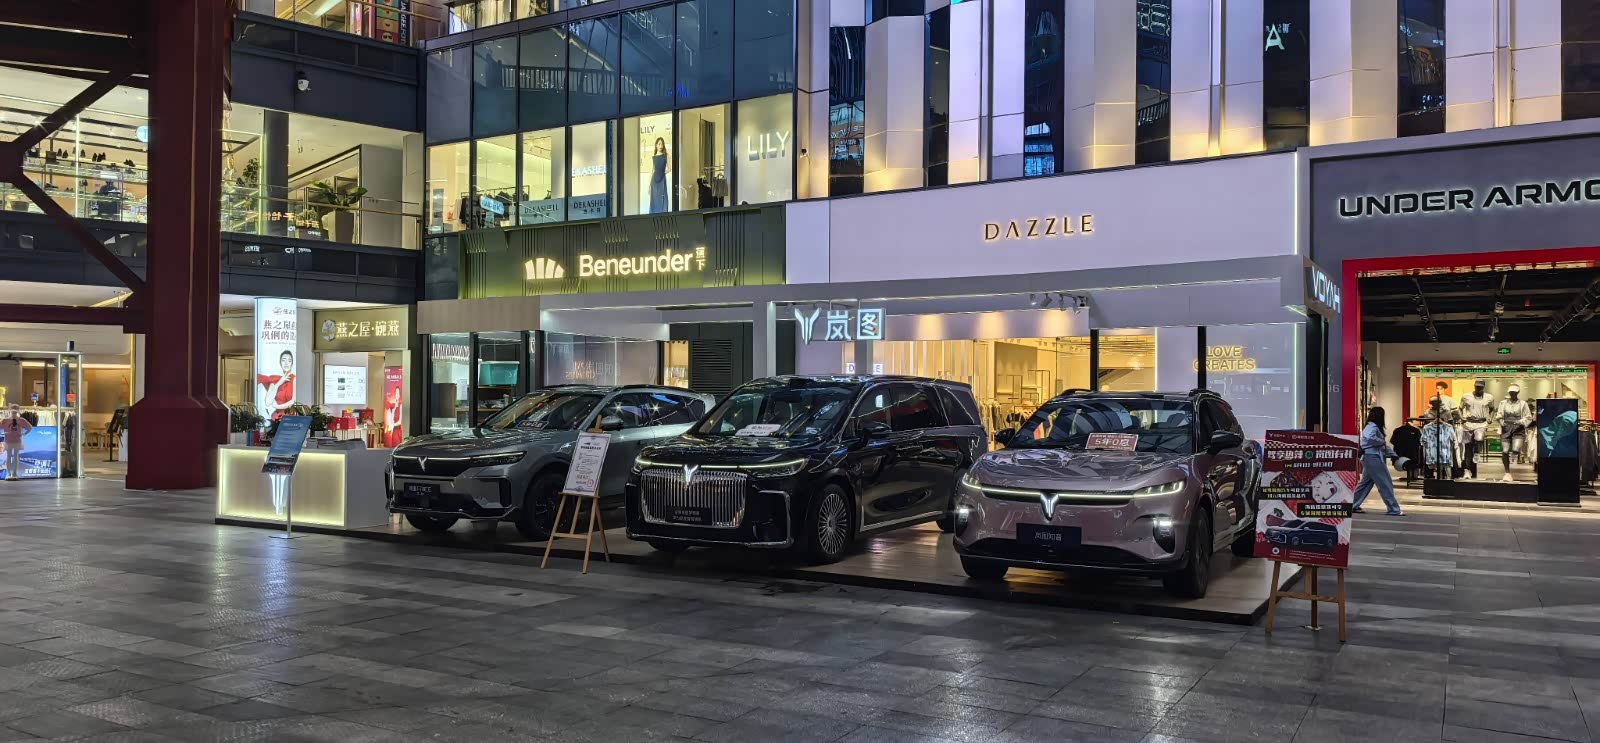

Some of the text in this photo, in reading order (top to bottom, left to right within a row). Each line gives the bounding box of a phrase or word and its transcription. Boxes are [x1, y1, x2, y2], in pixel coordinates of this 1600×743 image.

[640, 125, 655, 134] LILY
[747, 130, 790, 158] LILY
[1339, 188, 1474, 217] UNDER
[984, 214, 1093, 241] DAZZLE
[579, 248, 694, 278] Beneunder
[336, 320, 401, 339] 燕之屋·碗燕
[824, 308, 886, 341] 岚图
[1206, 346, 1243, 358] LOVE
